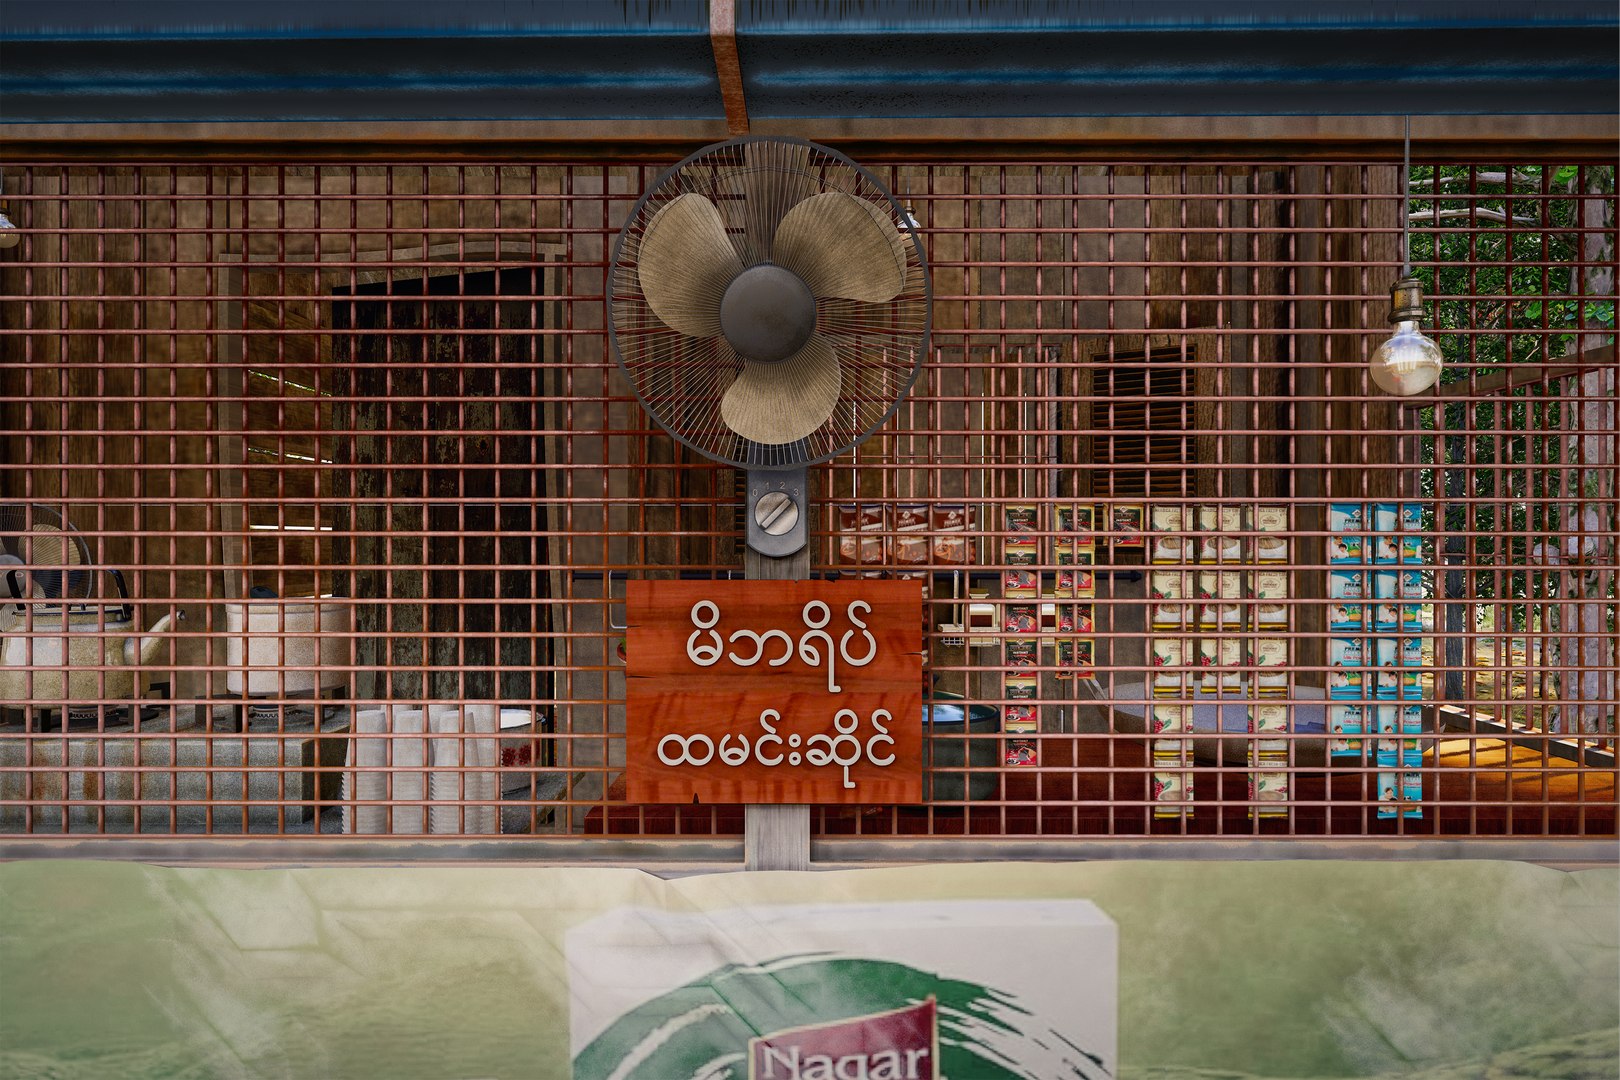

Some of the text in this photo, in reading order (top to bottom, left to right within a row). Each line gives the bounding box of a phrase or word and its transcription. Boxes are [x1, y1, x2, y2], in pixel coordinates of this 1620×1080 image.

[752, 482, 800, 497] 0 1 2 3
[687, 600, 877, 693] မိဘရိပ်
[657, 708, 896, 789] ထမင်းဆိုင်
[762, 1045, 930, 1080] Nagar
